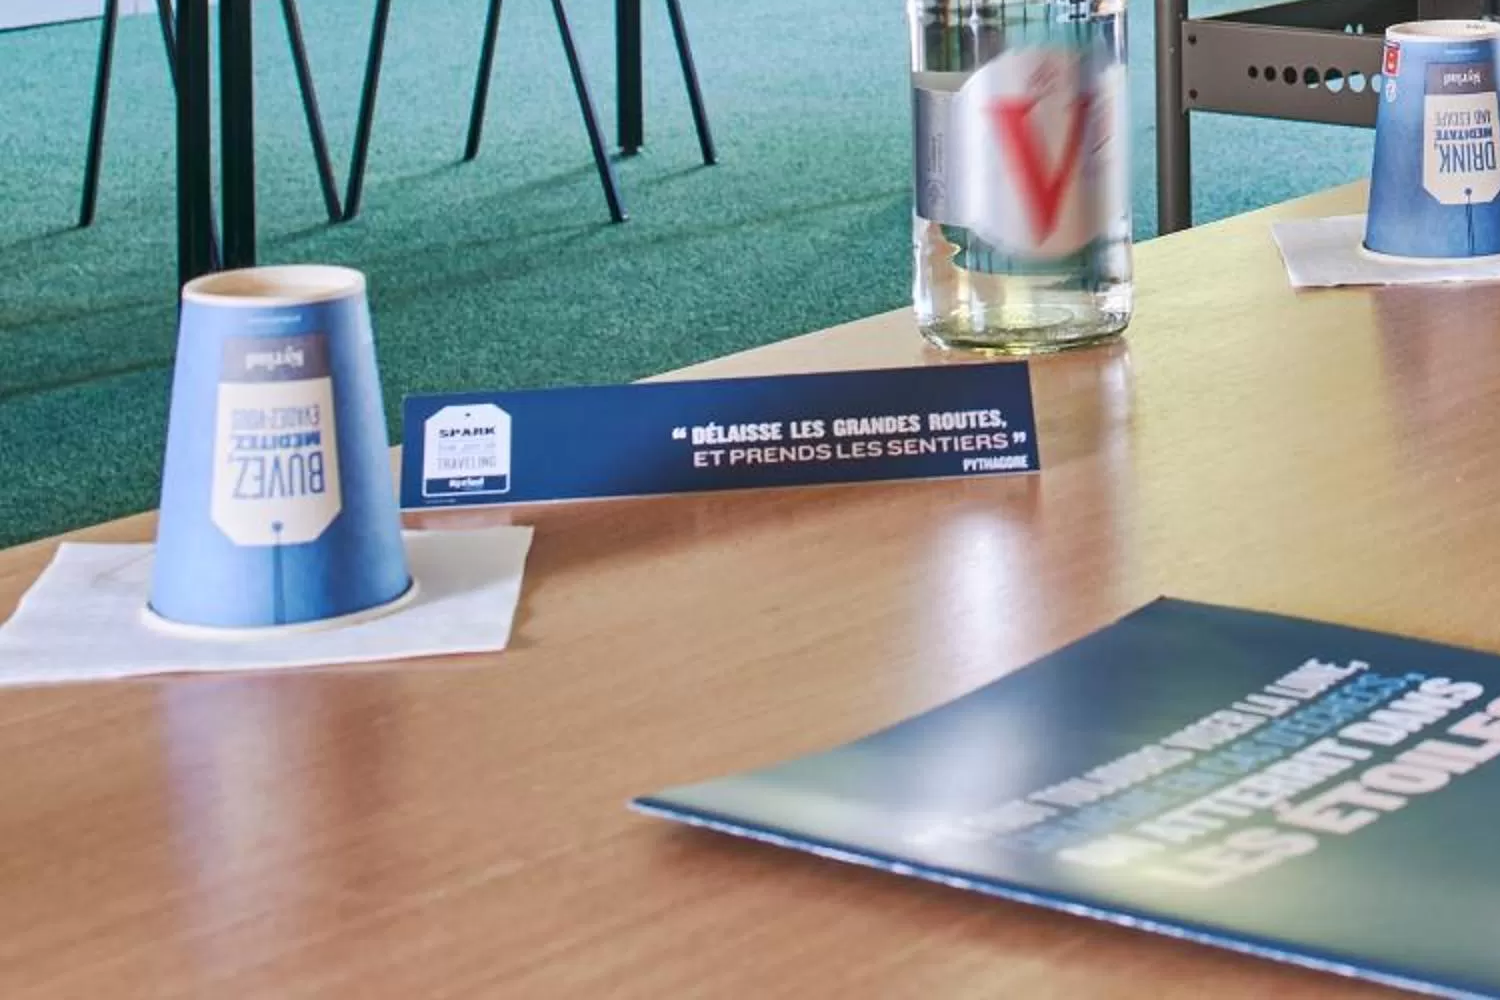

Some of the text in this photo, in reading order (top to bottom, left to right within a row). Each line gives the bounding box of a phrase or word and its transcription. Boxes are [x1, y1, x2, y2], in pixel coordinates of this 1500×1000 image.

[439, 426, 496, 438] SPARK
[790, 419, 825, 439] LES
[833, 413, 921, 437] GRANDES
[928, 409, 1007, 431] ROUTES,
[693, 450, 725, 468] ET
[729, 443, 832, 466] PRENDS
[836, 440, 883, 460] LES
[1137, 738, 1373, 843] ATTERRIT
[1340, 676, 1485, 746] DANS
[1143, 826, 1319, 888] LES
